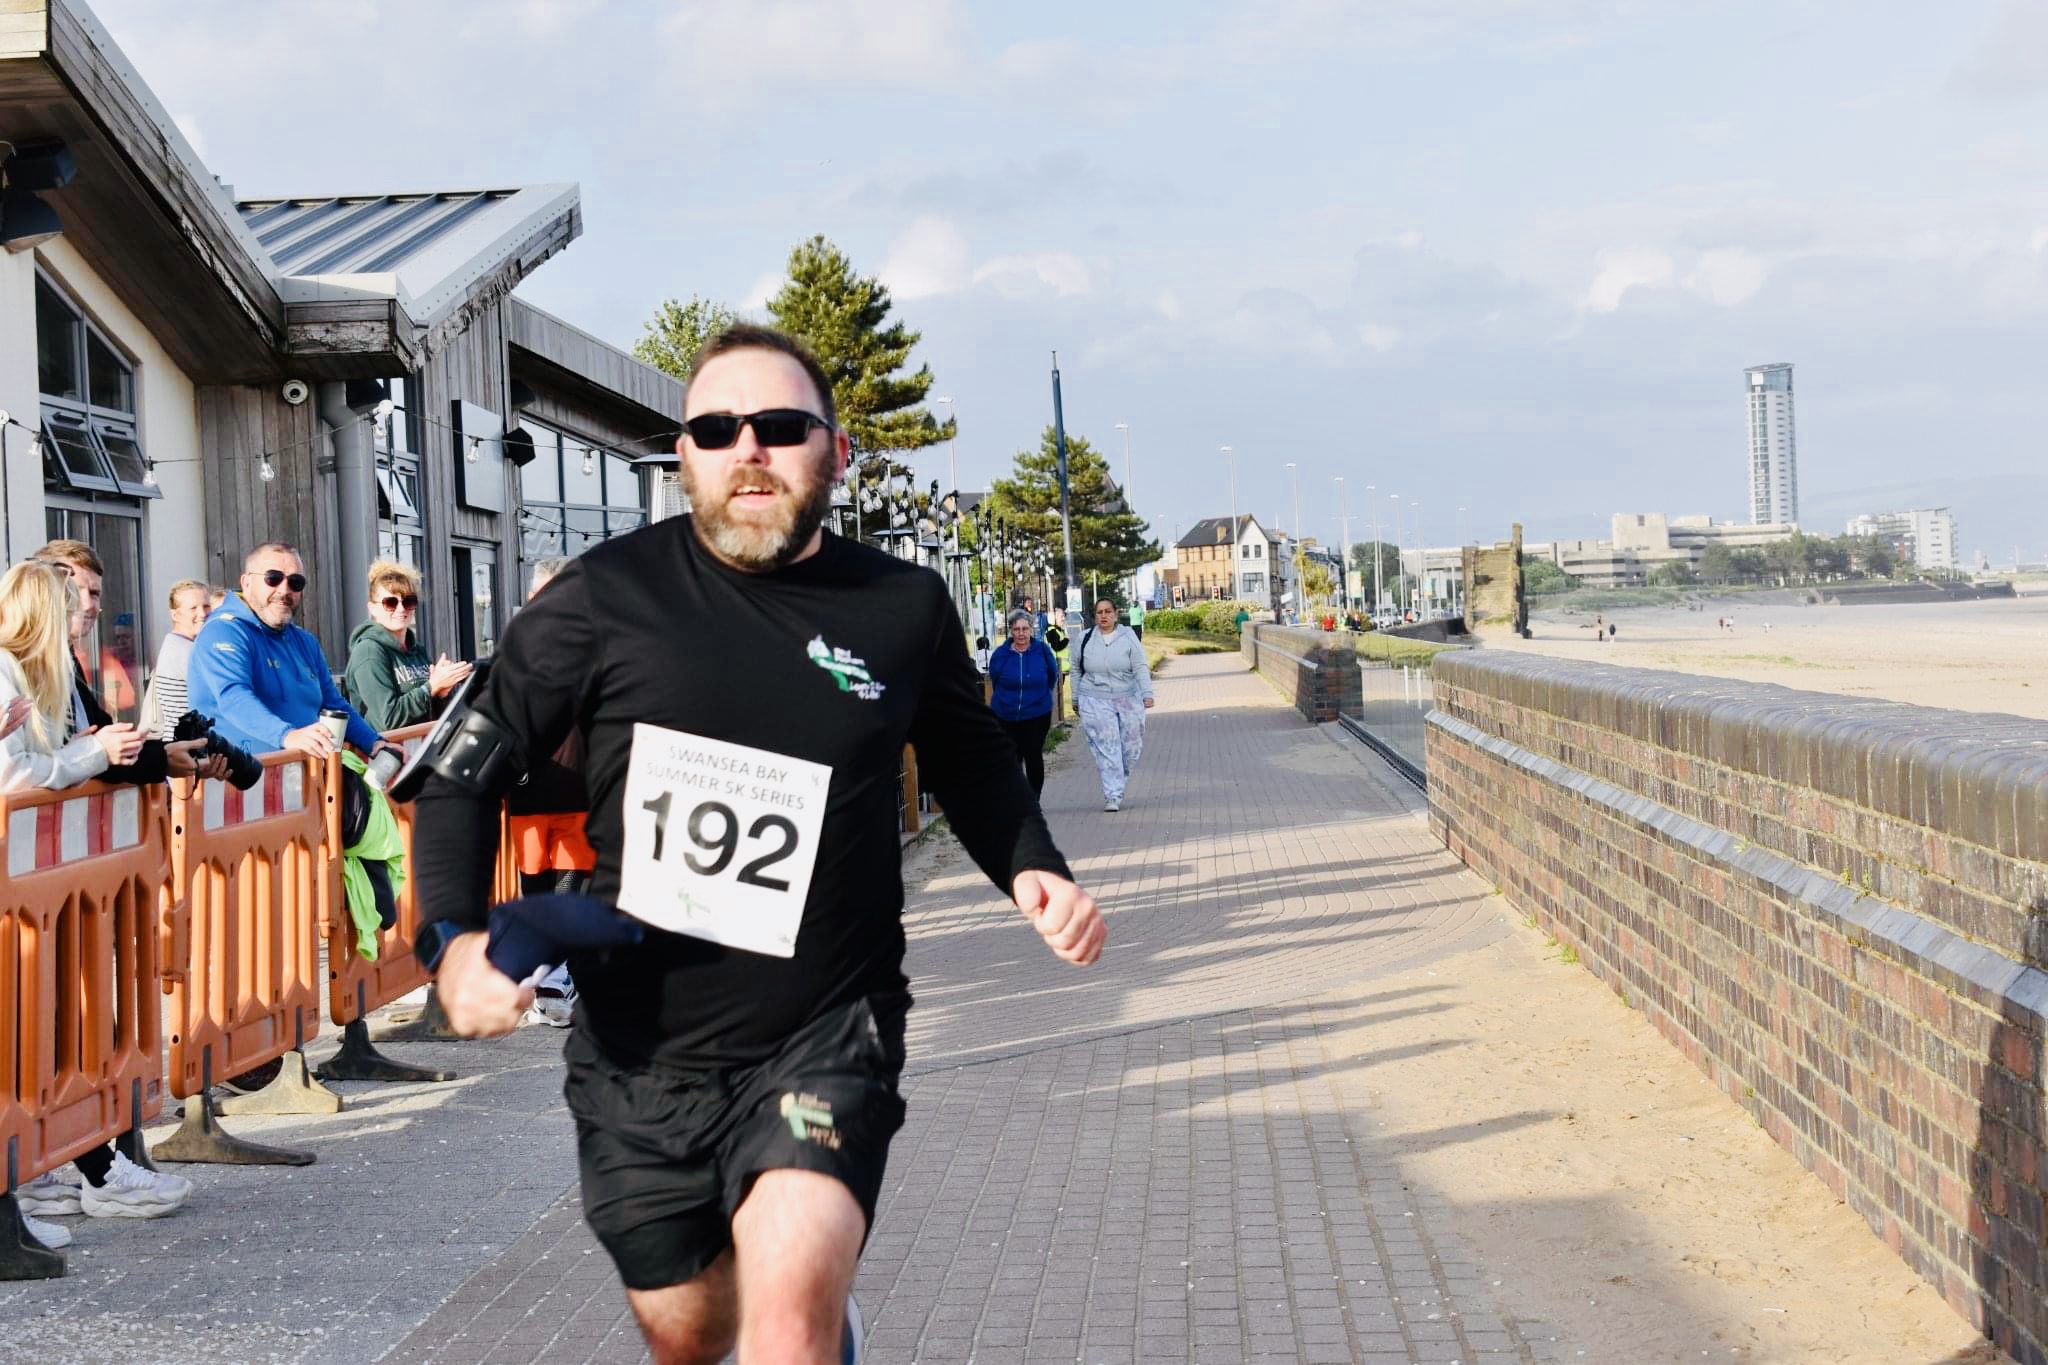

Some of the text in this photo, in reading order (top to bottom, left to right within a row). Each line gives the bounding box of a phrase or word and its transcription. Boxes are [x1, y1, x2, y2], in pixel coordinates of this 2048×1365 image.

[647, 762, 805, 810] SUMMER 5K SERIES
[670, 745, 788, 783] SWANSEA BAY
[642, 790, 800, 893] 192
